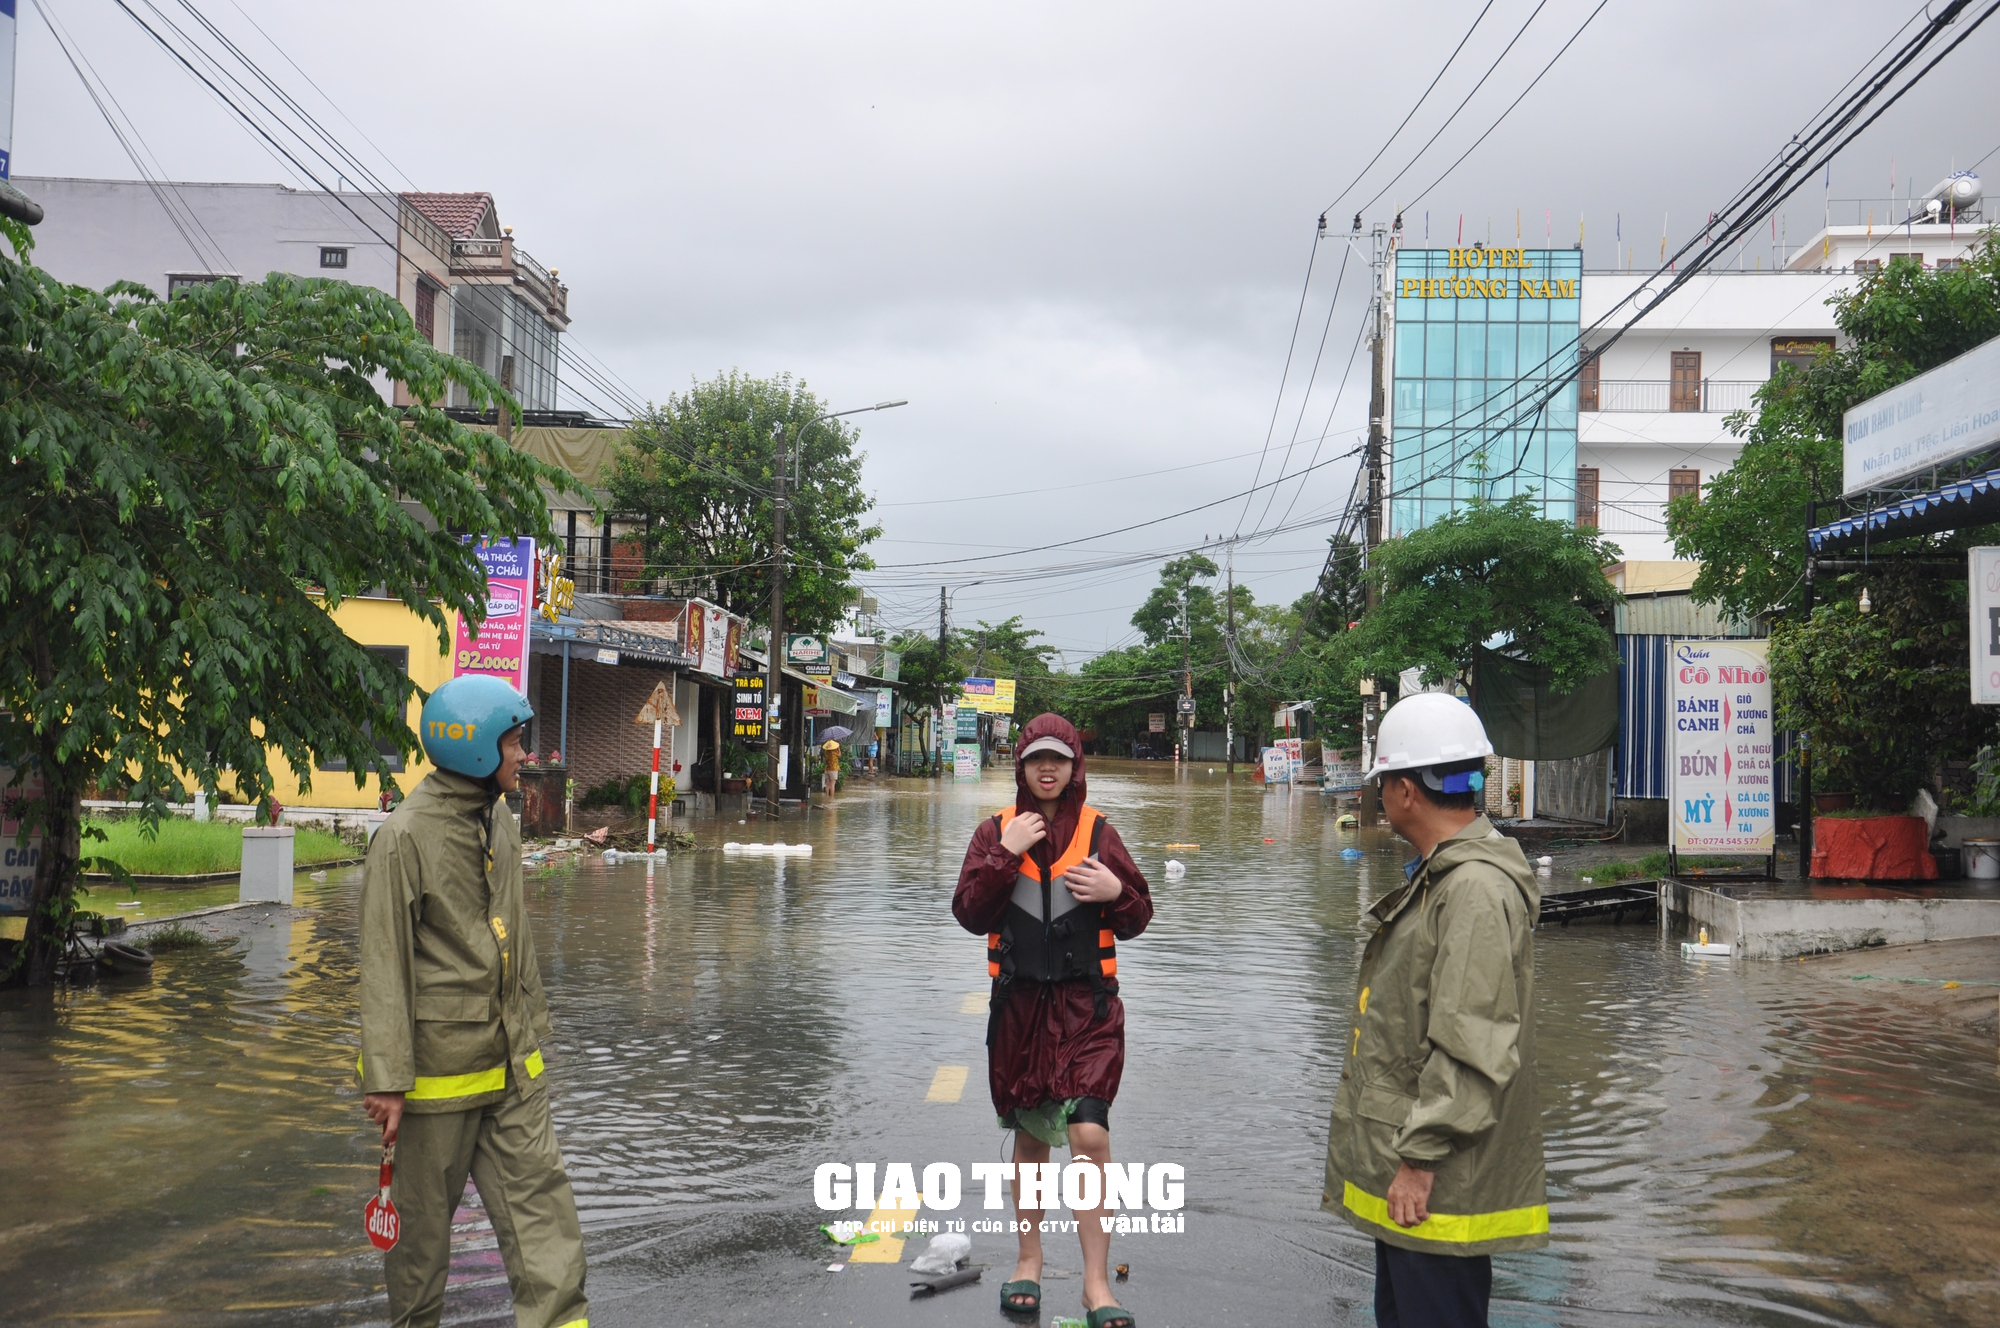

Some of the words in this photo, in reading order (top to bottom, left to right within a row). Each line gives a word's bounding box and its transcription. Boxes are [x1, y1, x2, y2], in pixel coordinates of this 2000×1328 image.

[1448, 248, 1533, 268] HOTEL
[1402, 274, 1508, 298] PHƯƠNG
[1519, 279, 1576, 298] NAM
[1847, 414, 1869, 445] QUÁN
[1897, 392, 1922, 422] CANH
[1942, 421, 1969, 442] Liên
[491, 551, 518, 562] THUỐC
[496, 564, 522, 576] CHÂU
[458, 650, 520, 671] 92.000đ
[1677, 646, 1710, 664] Quán
[1680, 666, 1710, 684] Cô
[1718, 665, 1767, 684] Nhỏ
[736, 676, 748, 687] TRÀ
[736, 693, 752, 703] SINH
[754, 690, 762, 703] TỐ
[1677, 696, 1719, 712] BÁNH
[735, 708, 762, 720] KEM
[1737, 710, 1768, 719] XƯƠNG
[428, 721, 476, 741] TTGT
[1678, 718, 1719, 731] CANH
[1737, 722, 1755, 734] CHẢ
[1737, 743, 1749, 754] CÁ
[1680, 750, 1717, 776] BÚN
[1758, 758, 1770, 769] CÁ
[1738, 775, 1768, 784] XƯƠNG
[1738, 792, 1750, 802] CÁ
[1753, 792, 1770, 802] LÓC
[1684, 792, 1715, 823] MỲ
[1738, 808, 1769, 817] XƯƠNG
[1738, 822, 1752, 832] TÁI
[369, 1207, 396, 1240] STOP
